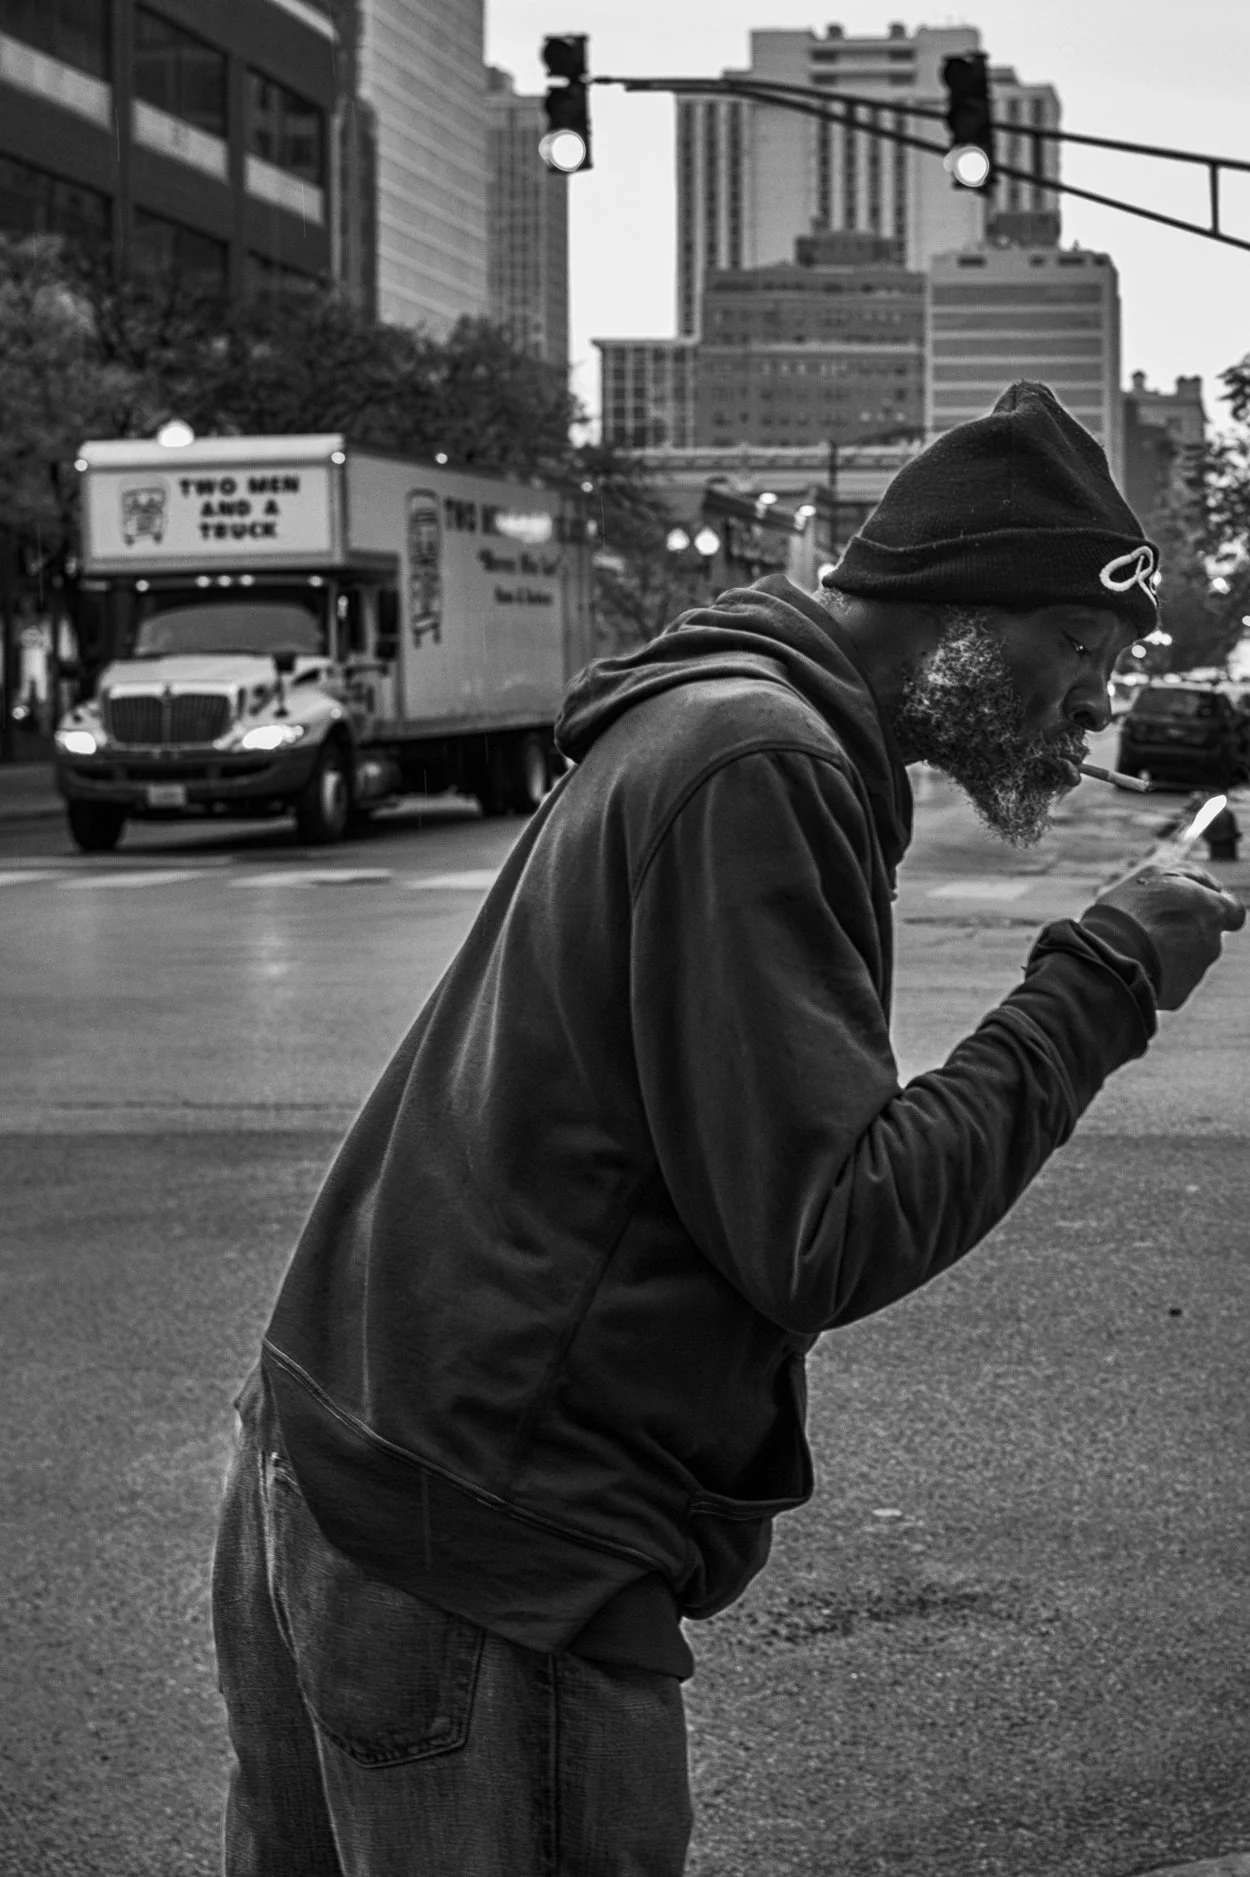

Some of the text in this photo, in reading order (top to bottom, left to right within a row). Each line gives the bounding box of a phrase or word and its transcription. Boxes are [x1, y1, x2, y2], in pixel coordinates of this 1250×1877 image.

[179, 475, 300, 498] TWO MEN
[201, 499, 280, 518] AND A
[200, 520, 277, 540] TRUCK
